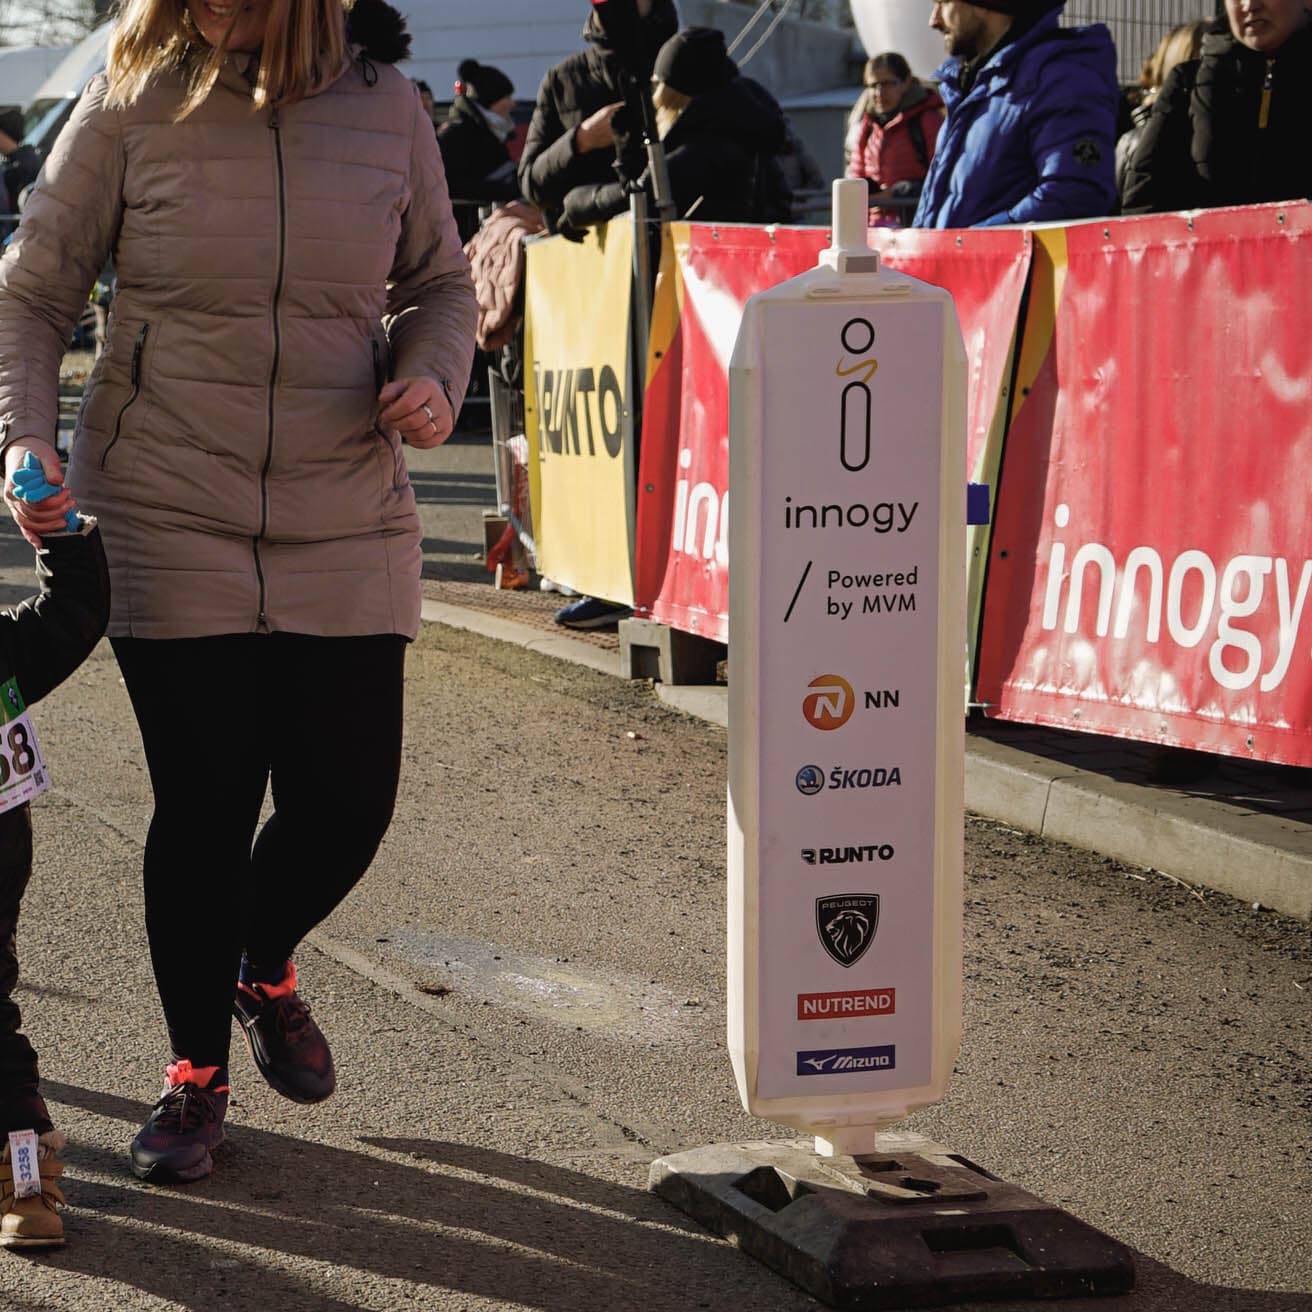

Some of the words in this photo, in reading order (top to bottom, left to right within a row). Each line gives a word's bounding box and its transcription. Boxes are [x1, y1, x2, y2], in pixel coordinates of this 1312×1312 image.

[784, 497, 919, 533] innogy
[828, 566, 918, 589] Powered
[827, 597, 853, 620] by
[862, 594, 916, 614] MVM
[1042, 503, 1312, 692] innogy
[864, 690, 900, 710] NN
[828, 766, 902, 789] ŠKODA
[819, 845, 894, 864] RUNTO
[822, 899, 874, 910] PEUGEOT
[803, 995, 891, 1015] NUTREND
[18, 1147, 32, 1181] 3258
